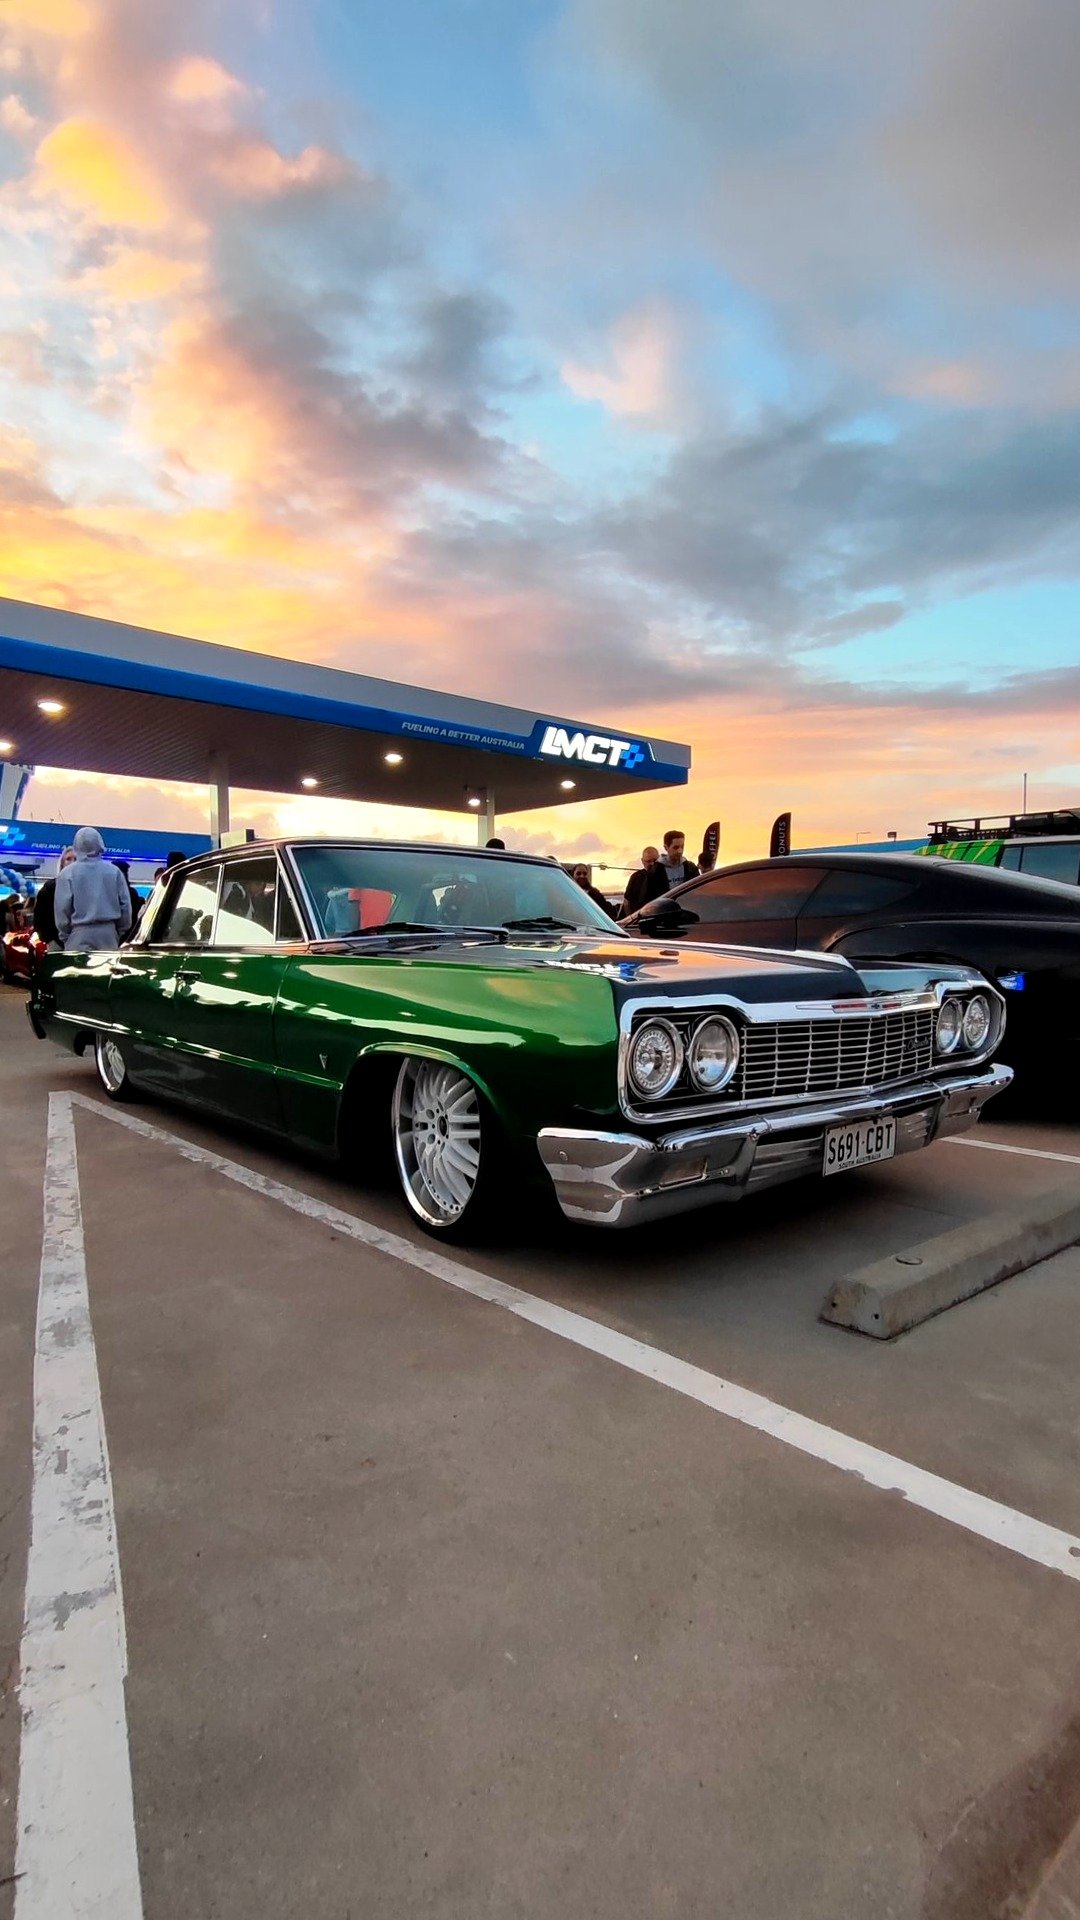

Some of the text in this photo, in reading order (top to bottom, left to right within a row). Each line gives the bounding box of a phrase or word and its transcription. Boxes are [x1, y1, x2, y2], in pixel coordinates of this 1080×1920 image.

[401, 722, 439, 735] FUELING
[448, 730, 480, 742] BETTER
[481, 736, 525, 750] AUSTRALIA
[778, 821, 786, 855] ONUTS
